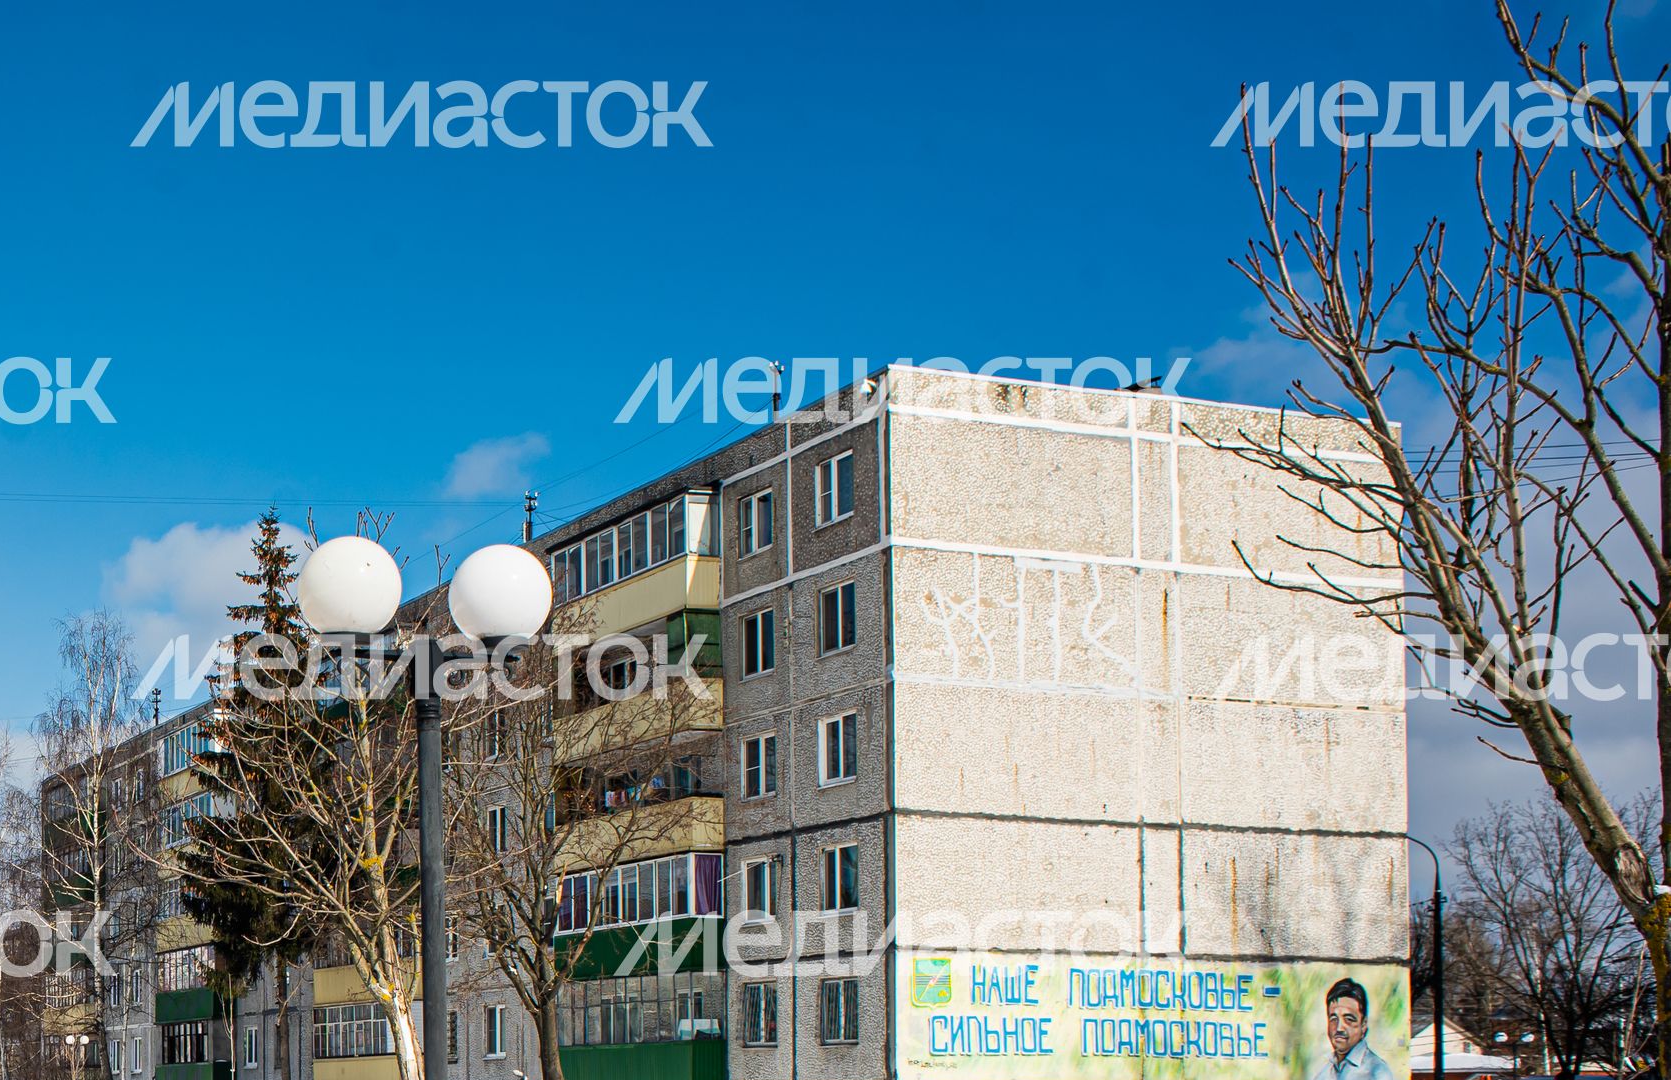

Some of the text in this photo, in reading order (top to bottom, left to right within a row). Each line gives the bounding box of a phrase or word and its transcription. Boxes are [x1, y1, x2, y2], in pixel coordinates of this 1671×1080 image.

[971, 964, 1039, 1005] НАШЕ
[1067, 967, 1254, 1011] ПОДМОСКОВЬЕ
[930, 1015, 1269, 1058] СИЛЬНОЕ ПОДМОСКОВЬЕ
